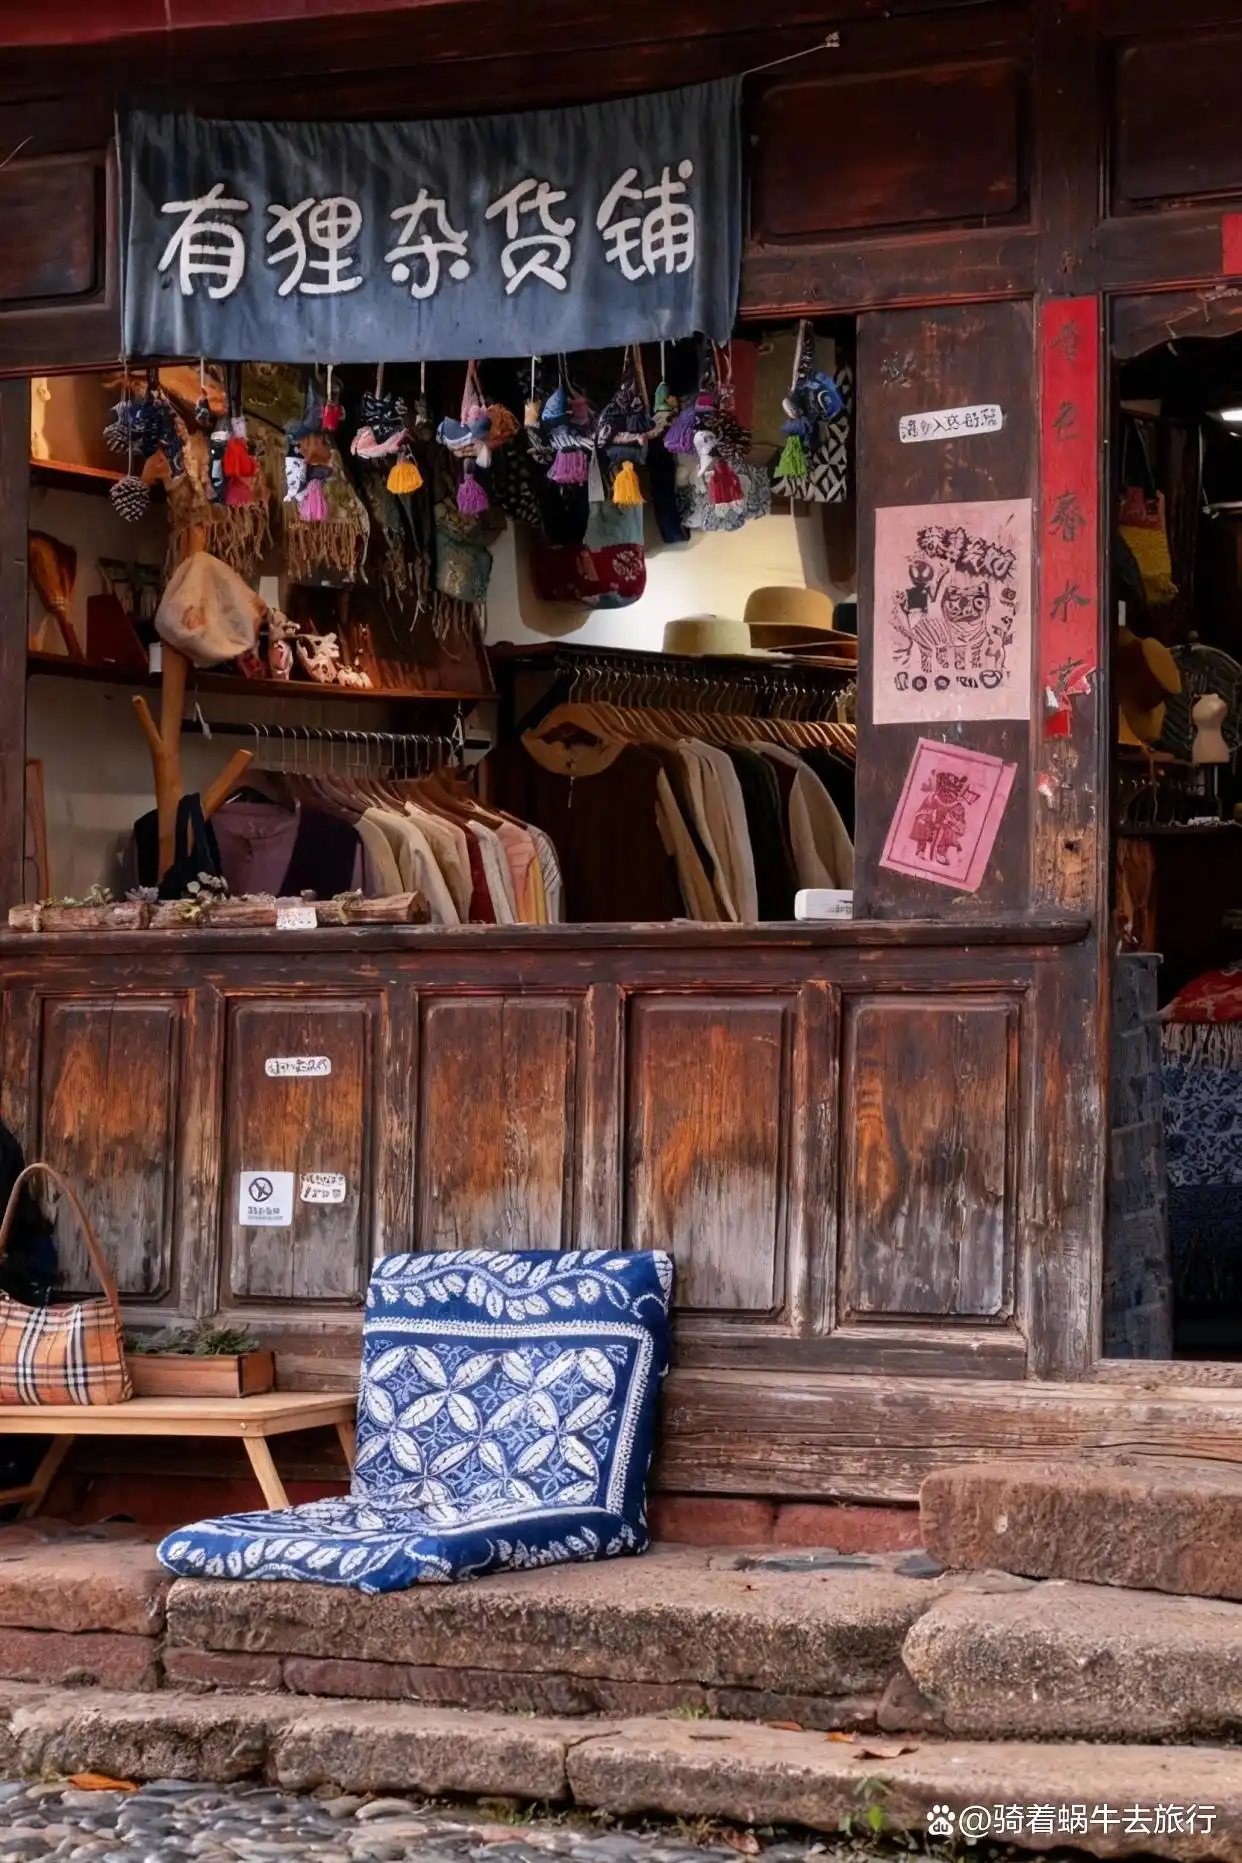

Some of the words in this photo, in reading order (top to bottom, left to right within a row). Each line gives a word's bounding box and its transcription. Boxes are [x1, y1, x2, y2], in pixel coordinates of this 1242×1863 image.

[157, 159, 697, 299] 有狸杂货铺
